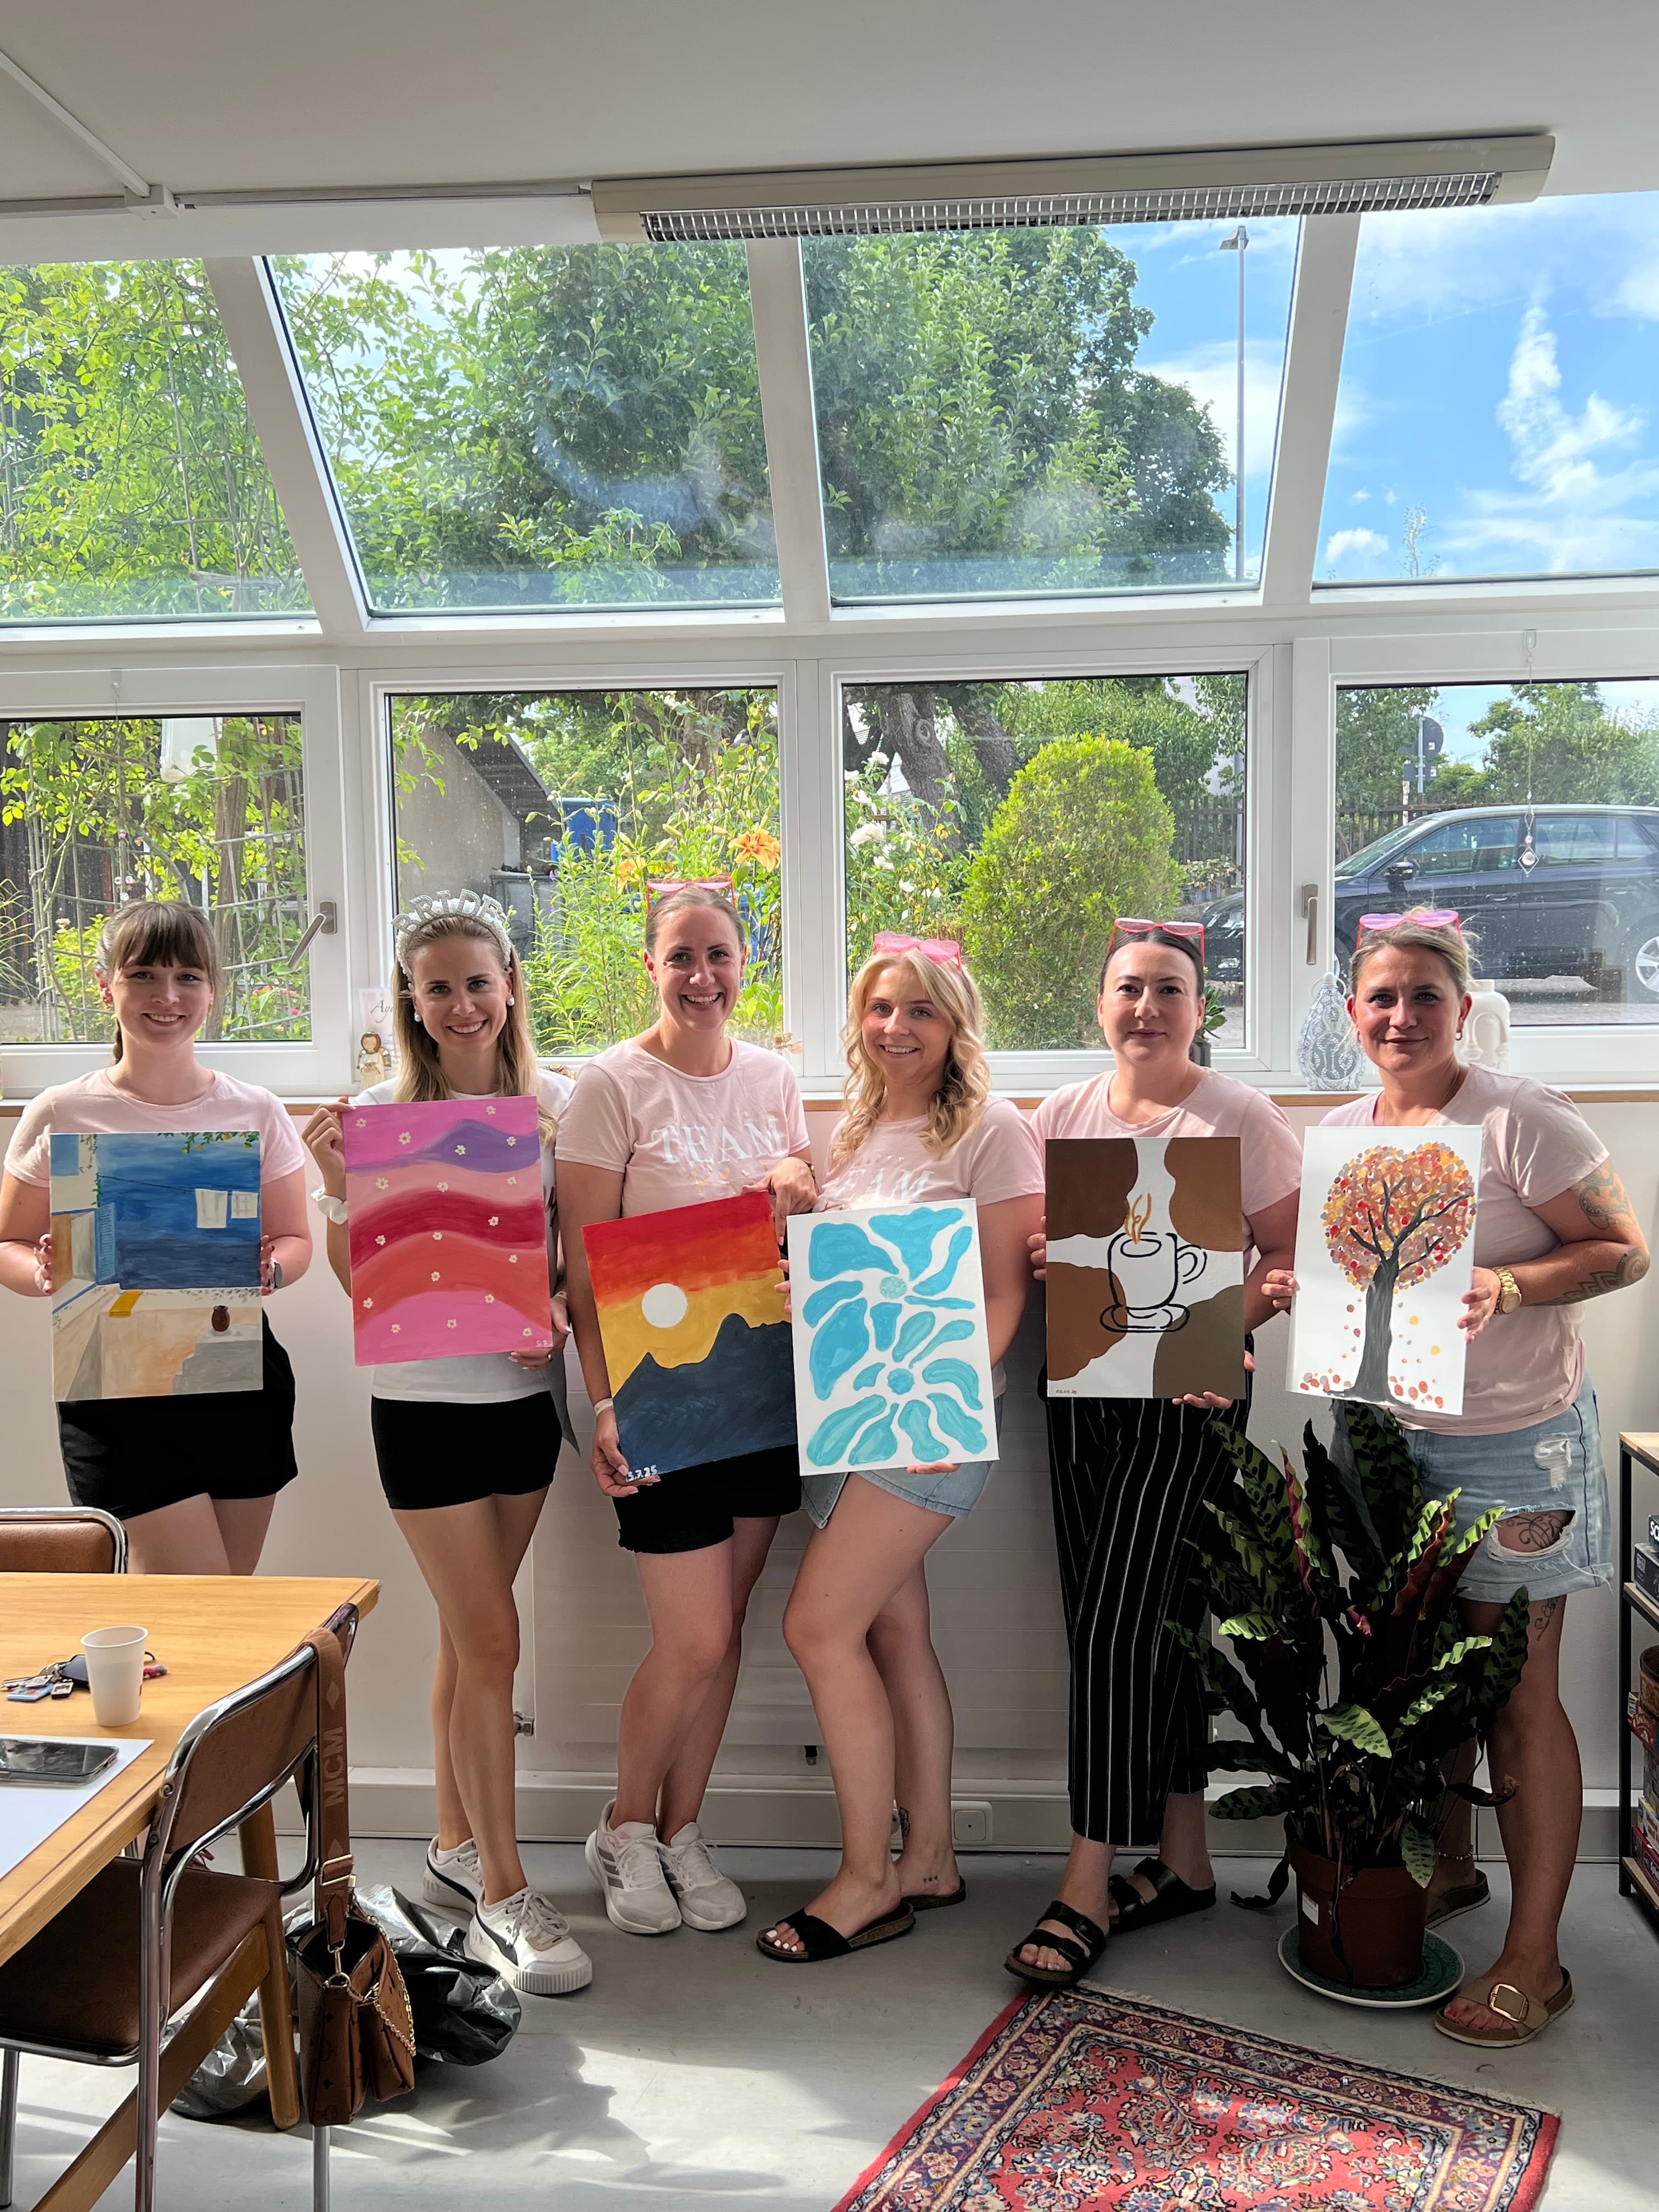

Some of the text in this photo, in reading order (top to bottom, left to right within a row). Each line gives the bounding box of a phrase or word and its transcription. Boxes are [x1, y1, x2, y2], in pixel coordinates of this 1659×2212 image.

[391, 888, 508, 935] BRIDE
[650, 1115, 789, 1164] TEAM
[823, 1167, 935, 1203] EAM
[628, 1464, 658, 1482] 5.7.25
[323, 1725, 345, 1809] MCM
